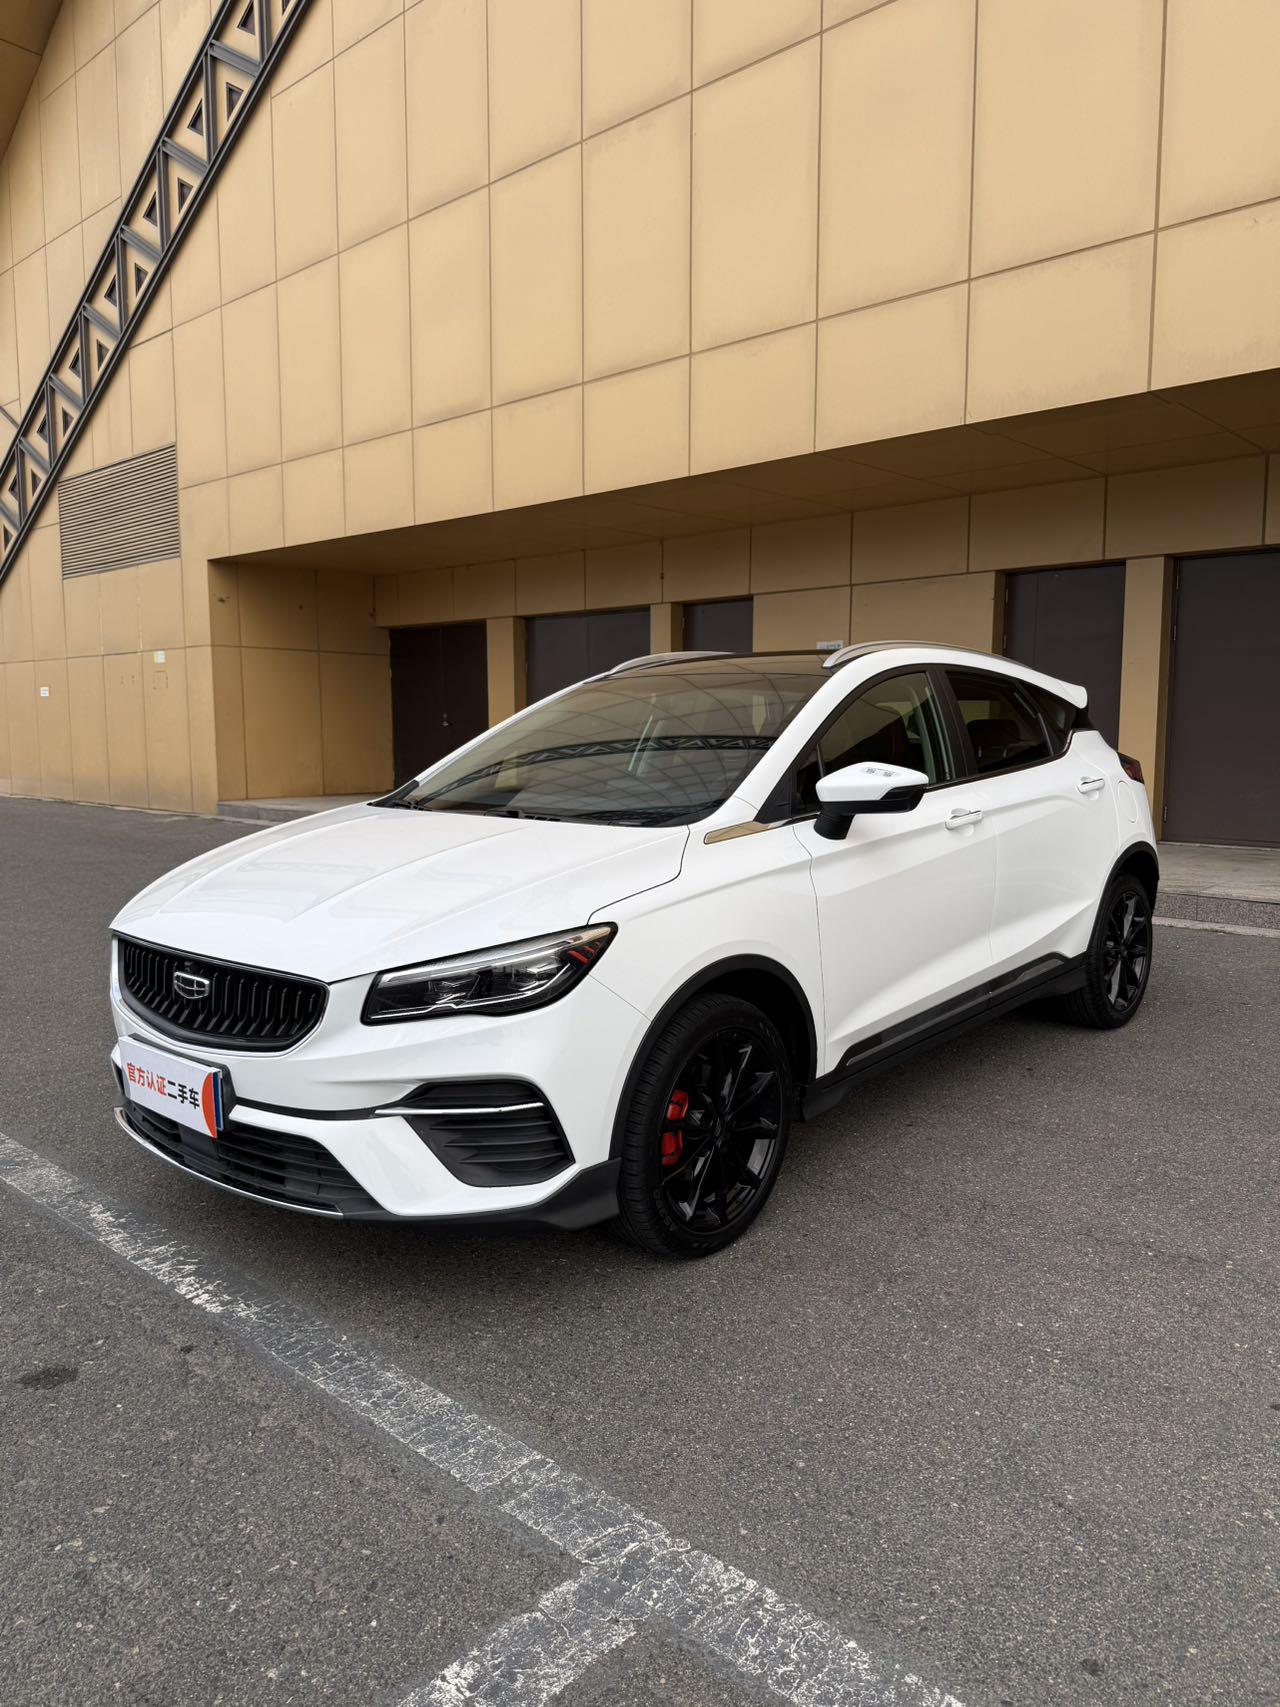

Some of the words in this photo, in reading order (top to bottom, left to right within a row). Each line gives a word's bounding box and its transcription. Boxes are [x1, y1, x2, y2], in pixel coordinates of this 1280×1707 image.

[127, 1062, 200, 1109] 官方认证二手车
